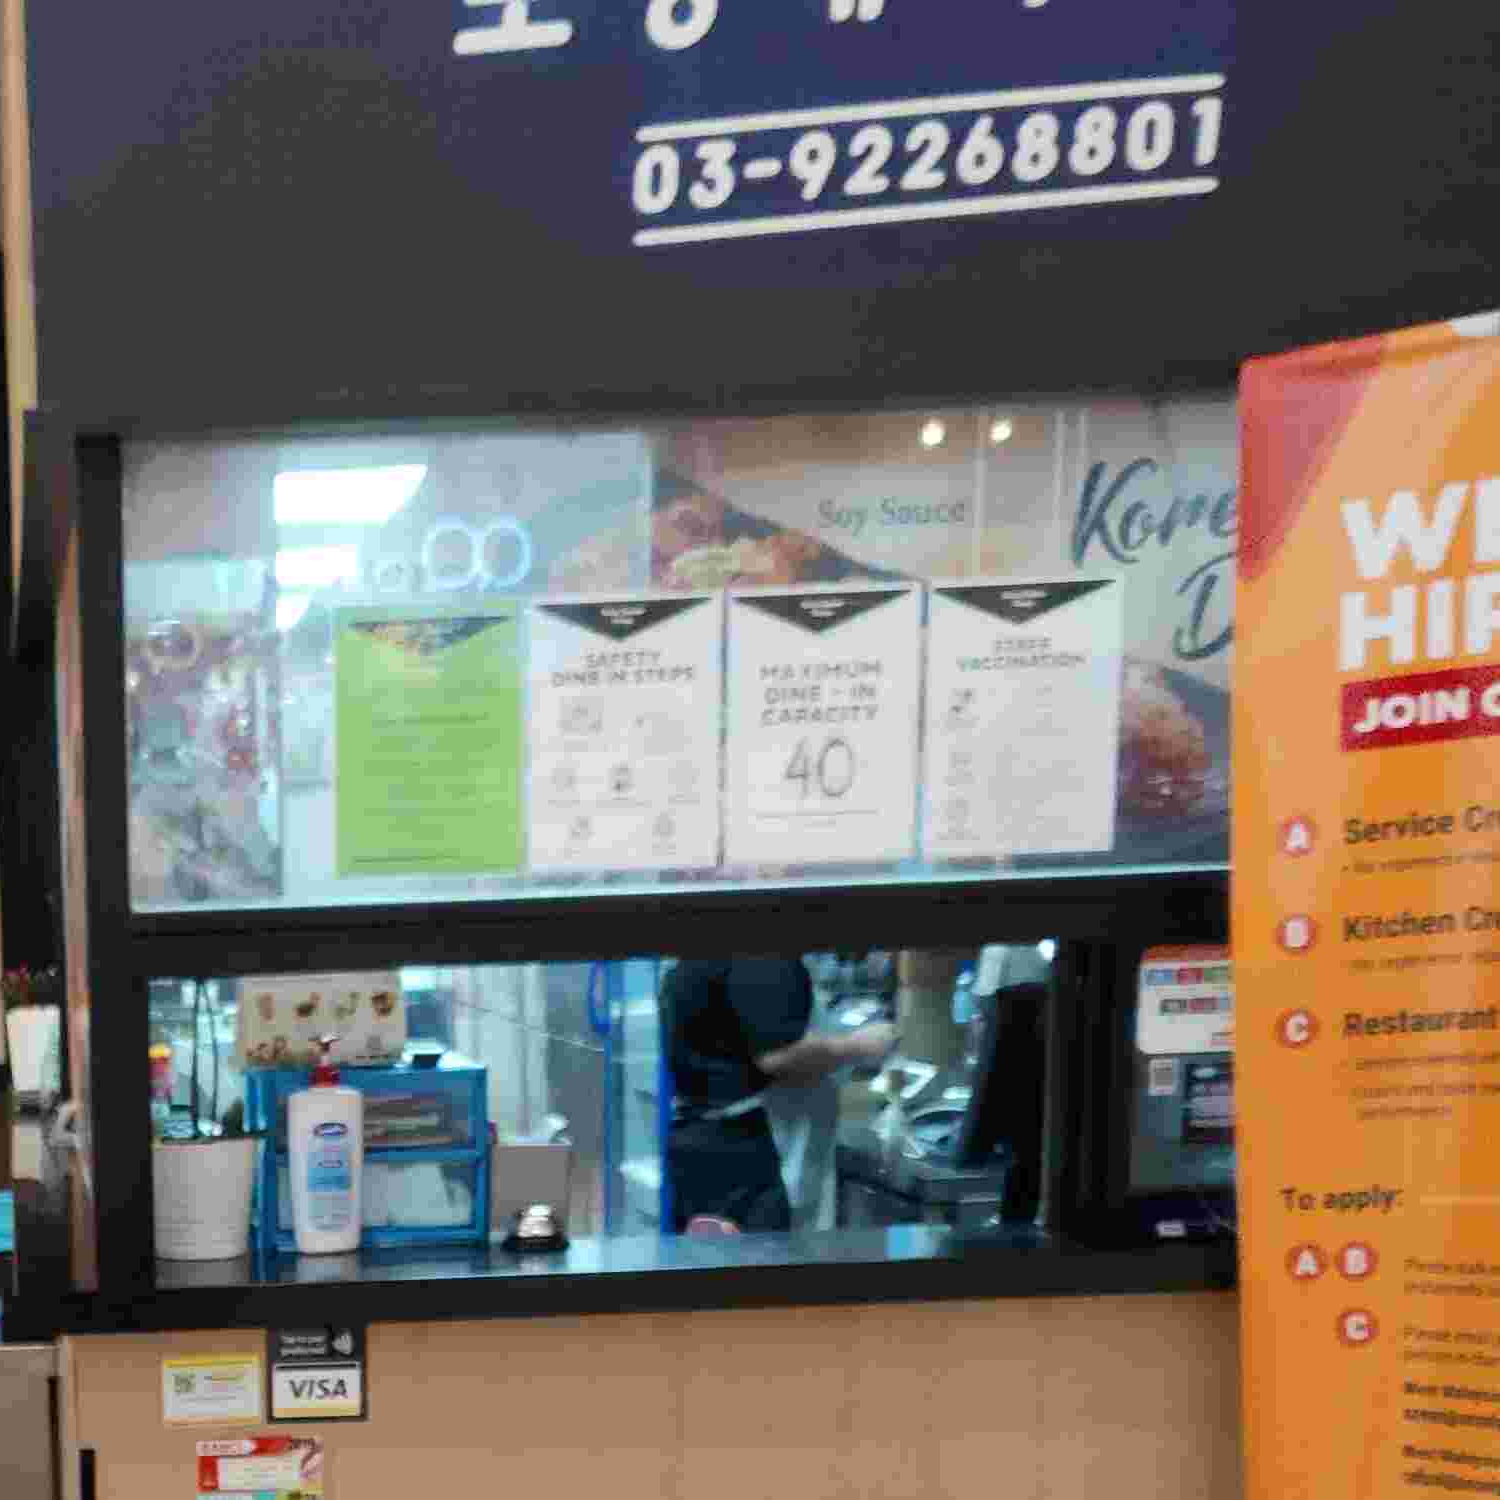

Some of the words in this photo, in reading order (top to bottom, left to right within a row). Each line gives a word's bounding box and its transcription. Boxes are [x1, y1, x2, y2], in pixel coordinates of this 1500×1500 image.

[632, 95, 1223, 215] 03-92268801
[1352, 686, 1471, 734] JOIN
[784, 737, 856, 799] 40
[1343, 810, 1455, 844] Service
[1343, 909, 1455, 943] Kitchen
[1343, 1005, 1498, 1039] Restaurant
[1280, 1186, 1316, 1212] To
[288, 1378, 349, 1400] VISA
